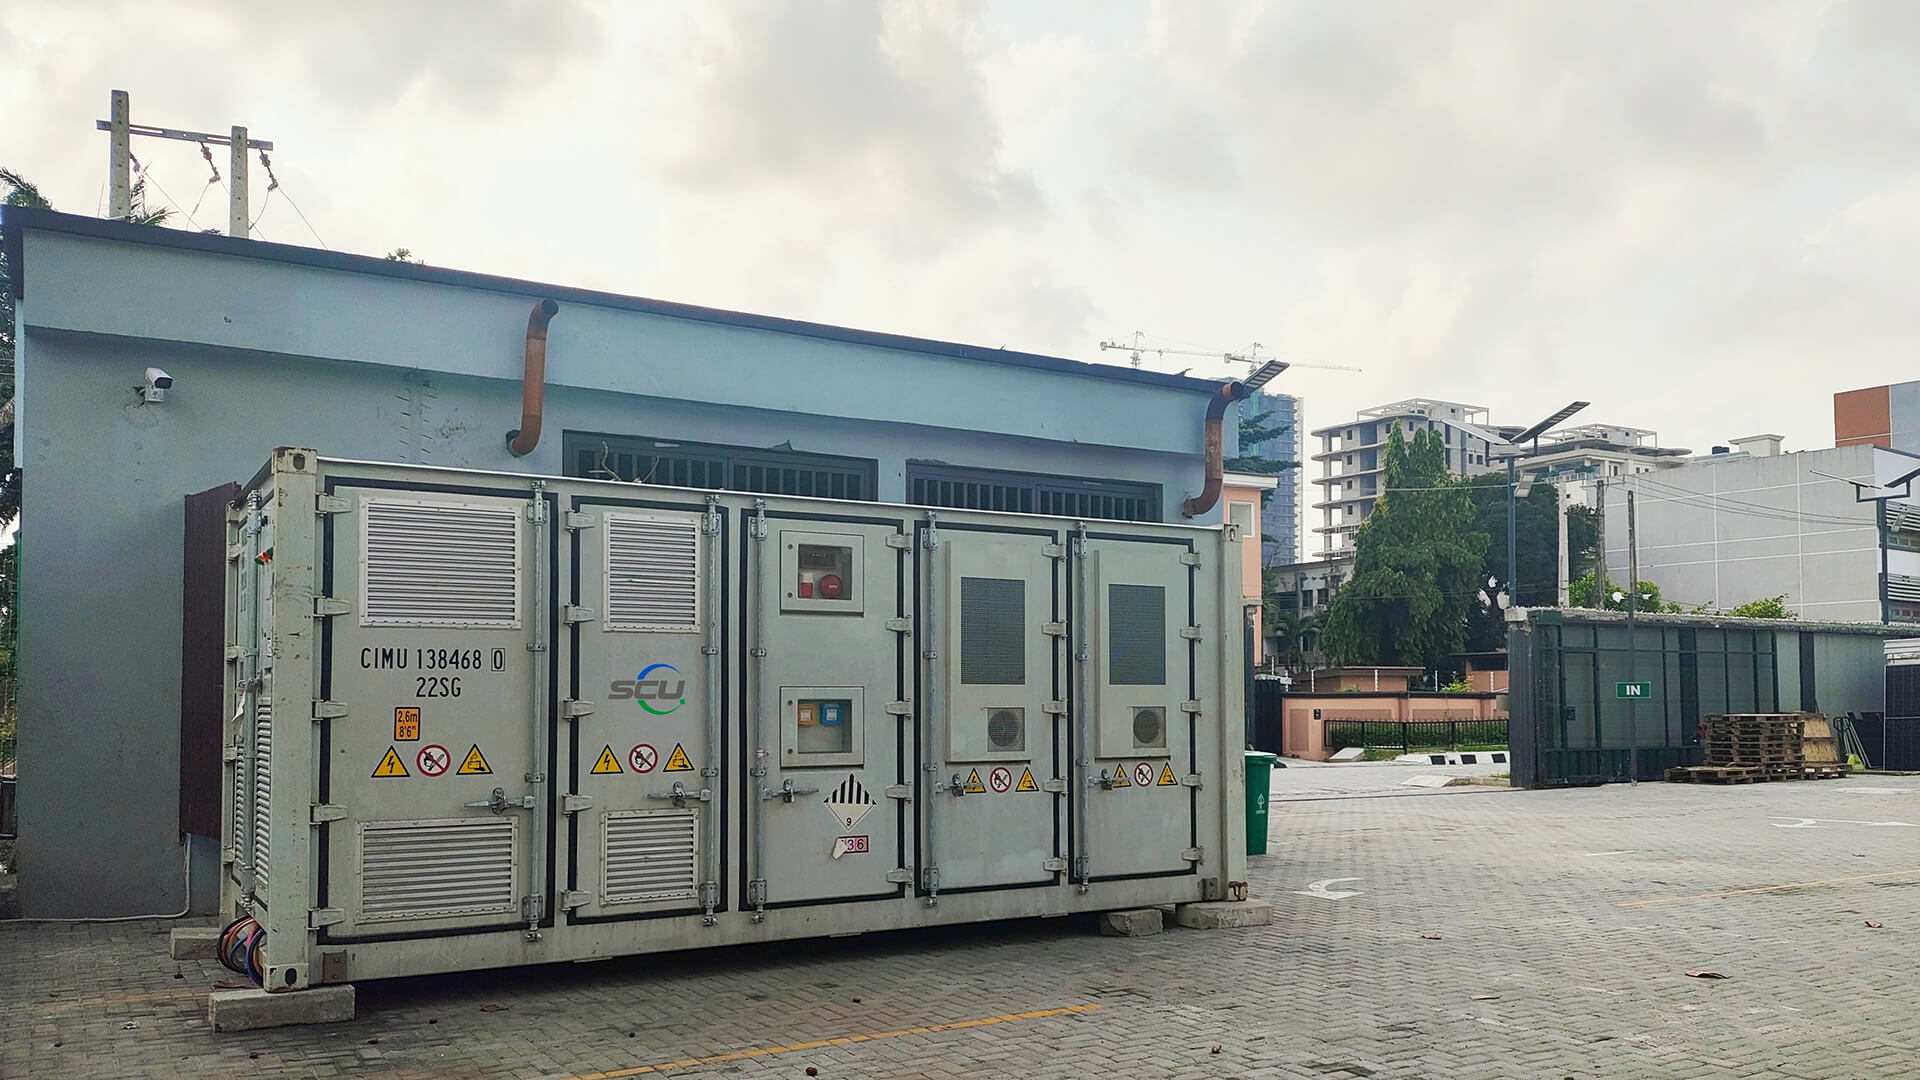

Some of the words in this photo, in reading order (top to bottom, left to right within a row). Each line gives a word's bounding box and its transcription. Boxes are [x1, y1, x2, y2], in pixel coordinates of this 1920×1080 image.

[361, 648, 408, 669] CIMU
[416, 649, 482, 670] 138468
[416, 677, 461, 698] 22SG
[608, 680, 685, 700] SCU
[1626, 685, 1641, 696] IN
[398, 710, 418, 725] 2,6m
[846, 817, 852, 826] 9
